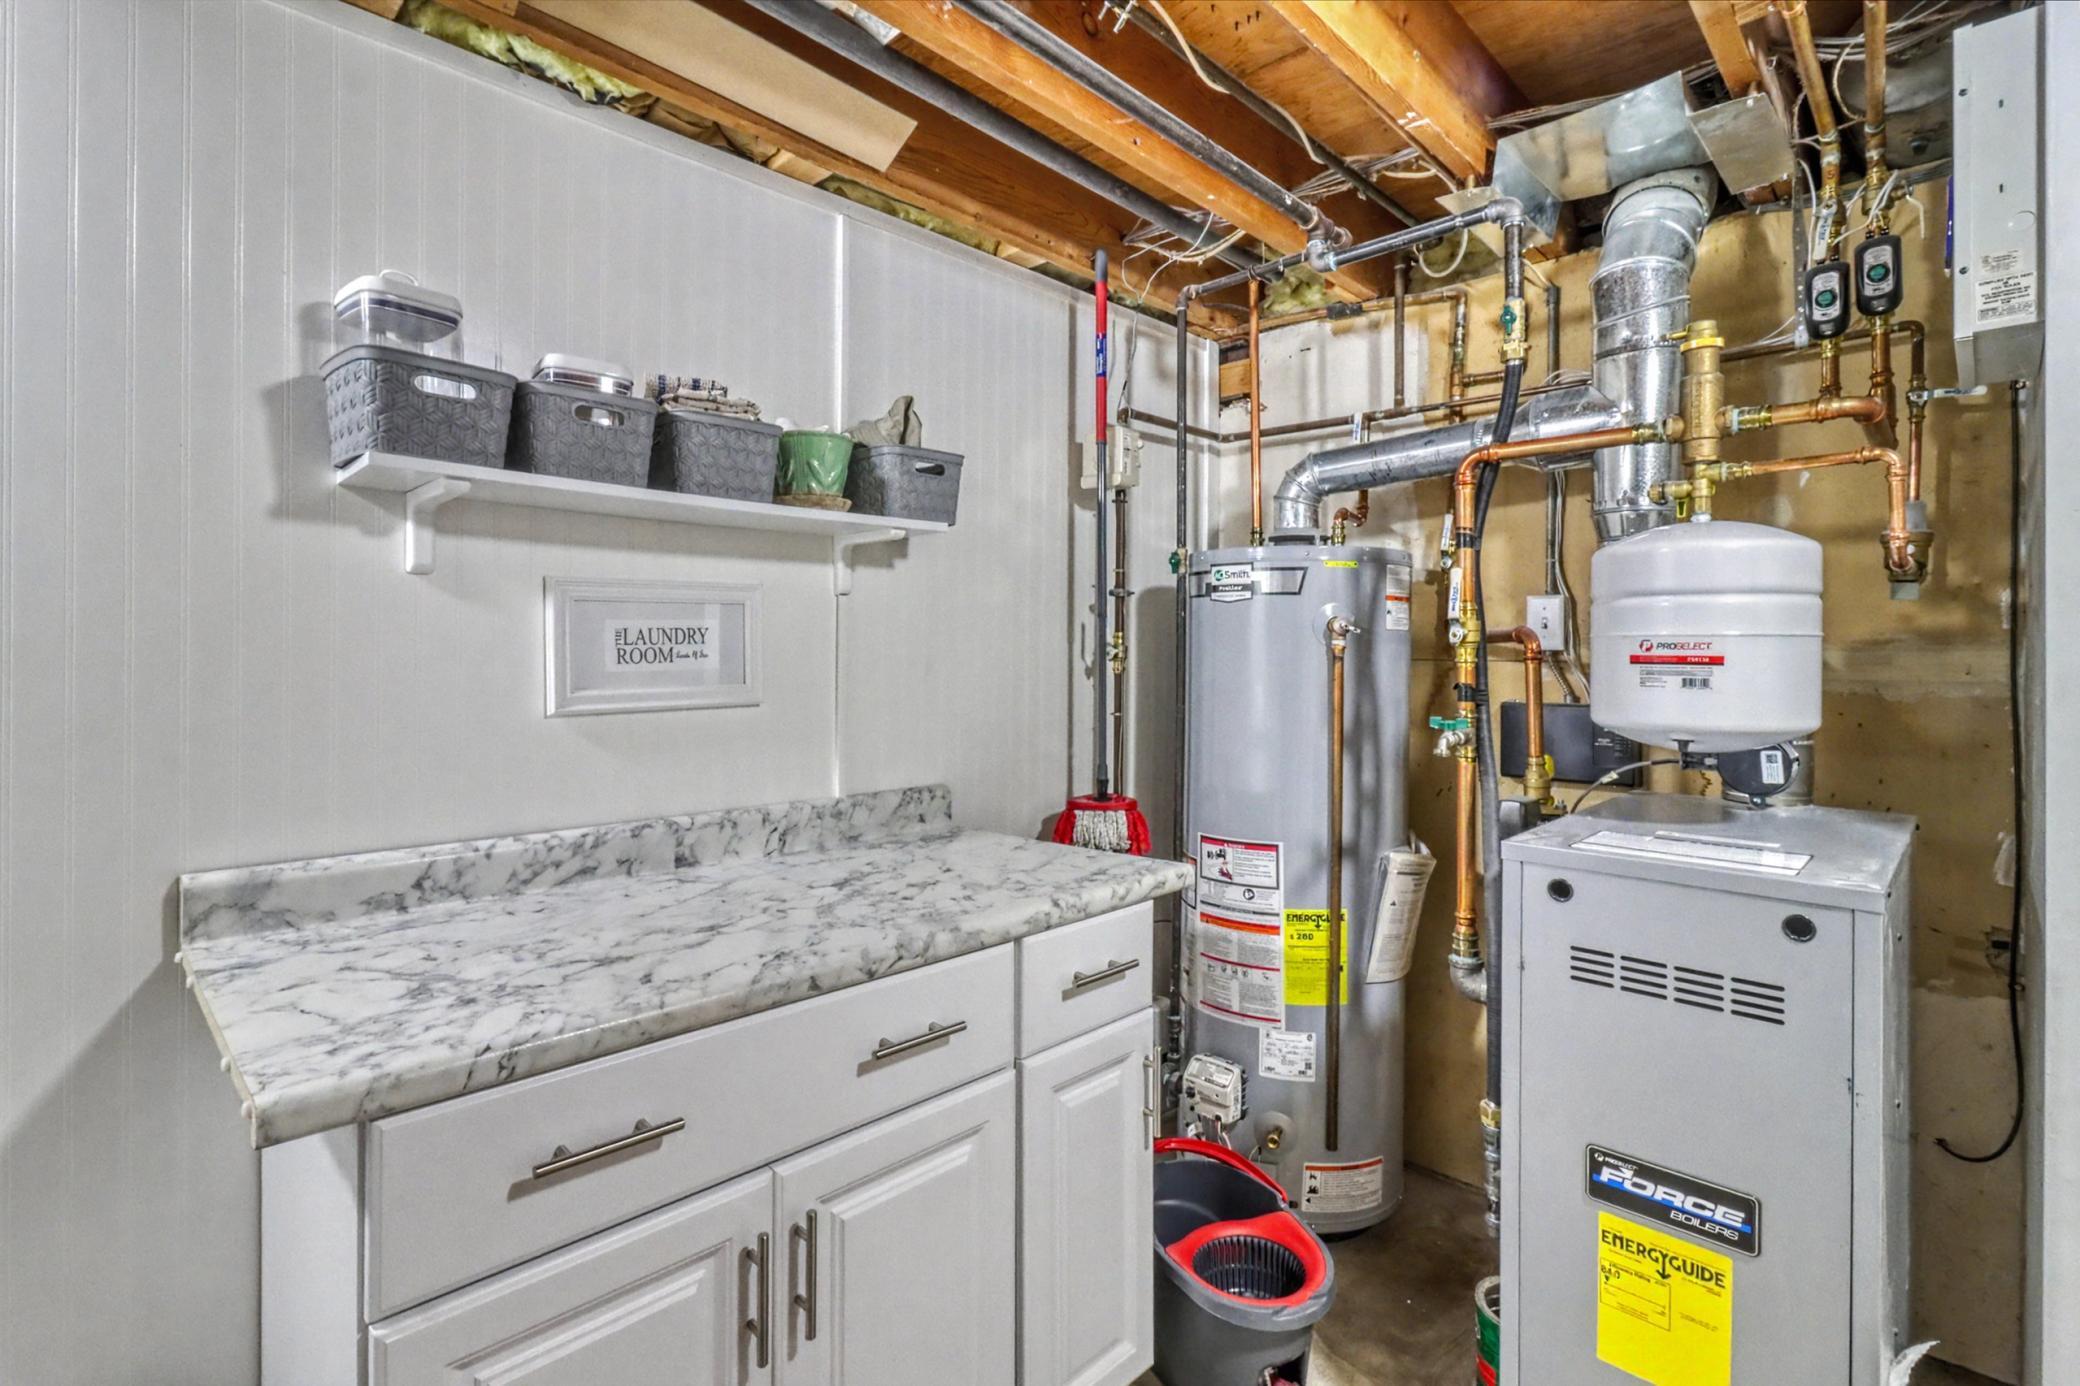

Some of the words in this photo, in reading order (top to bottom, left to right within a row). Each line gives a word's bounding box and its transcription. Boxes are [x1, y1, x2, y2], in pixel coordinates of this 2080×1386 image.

[623, 627, 709, 646] LAUNDRY
[1656, 642, 1713, 651] PROSELECT
[616, 646, 674, 665] ROOM
[1600, 1166, 1745, 1227] FORCE
[1669, 1210, 1739, 1241] BOILERS
[1601, 1228, 1727, 1289] ENERGYGUIDE
